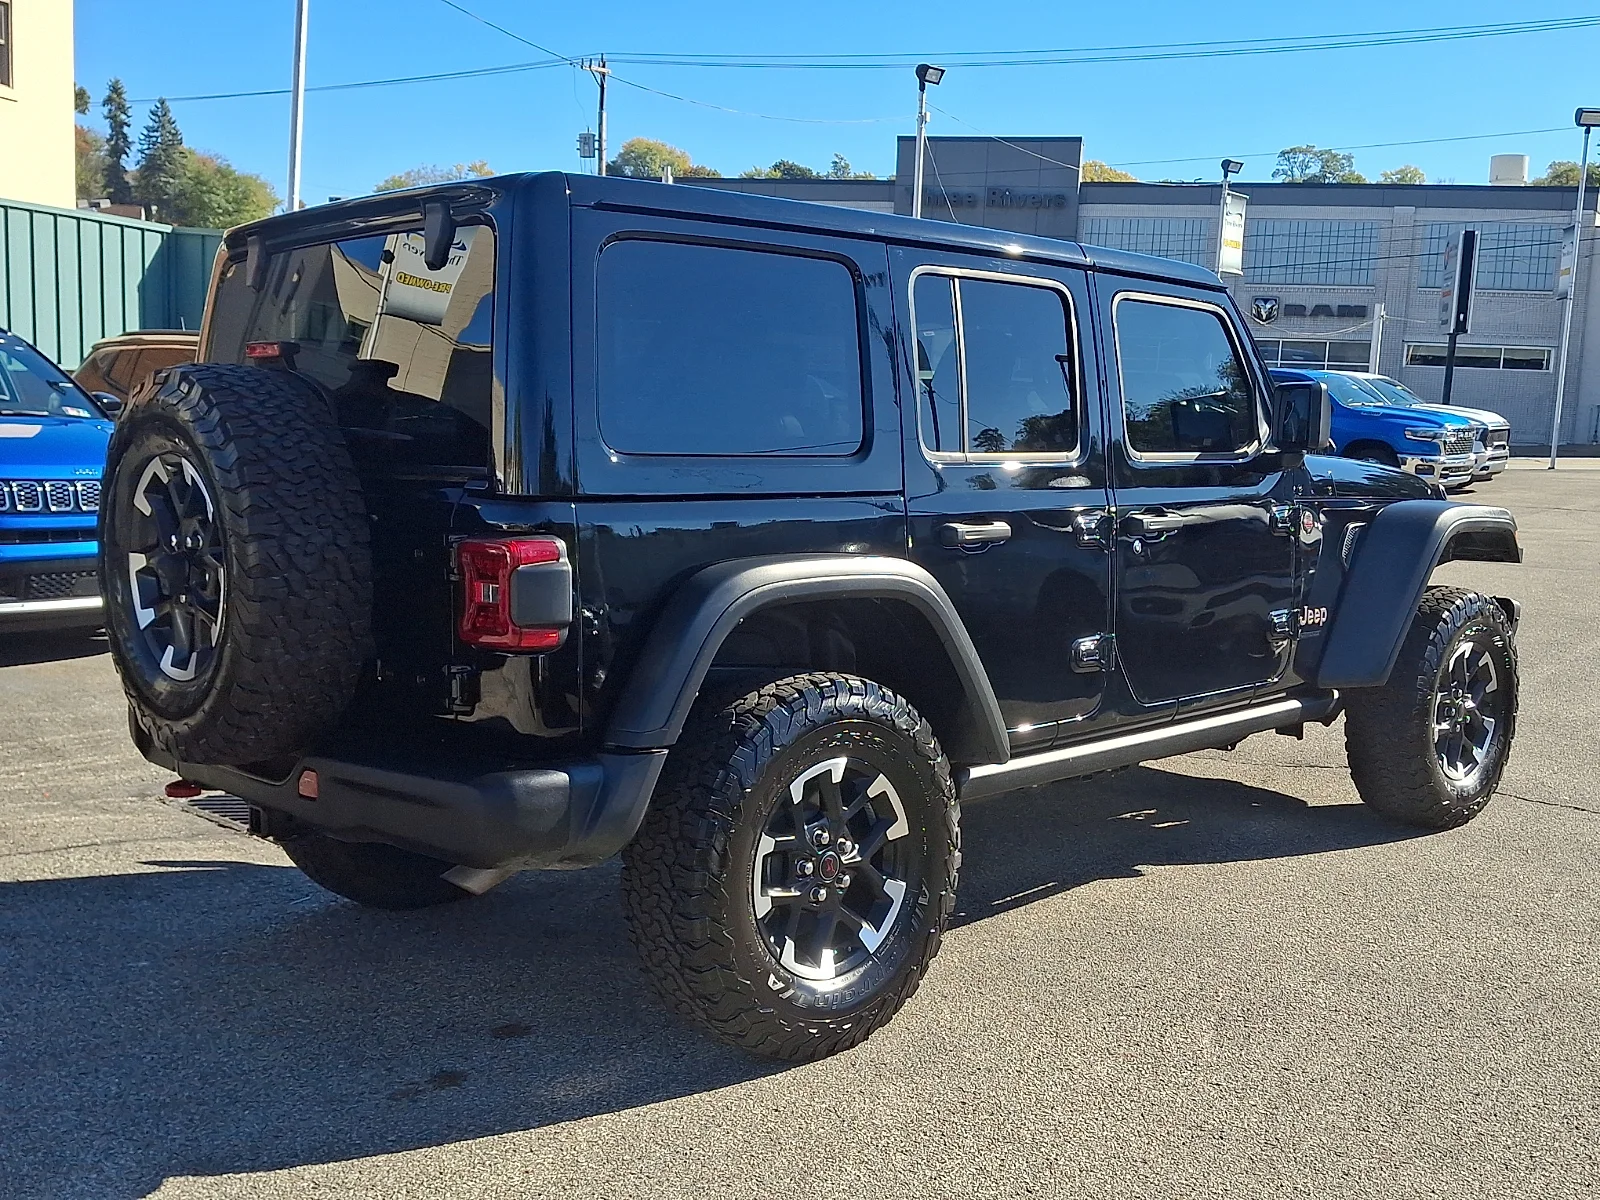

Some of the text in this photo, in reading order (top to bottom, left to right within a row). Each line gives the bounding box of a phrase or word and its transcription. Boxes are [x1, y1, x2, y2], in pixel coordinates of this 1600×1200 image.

[986, 187, 1067, 208] Rivers
[1284, 304, 1367, 318] RAM
[1300, 605, 1328, 627] Jeep
